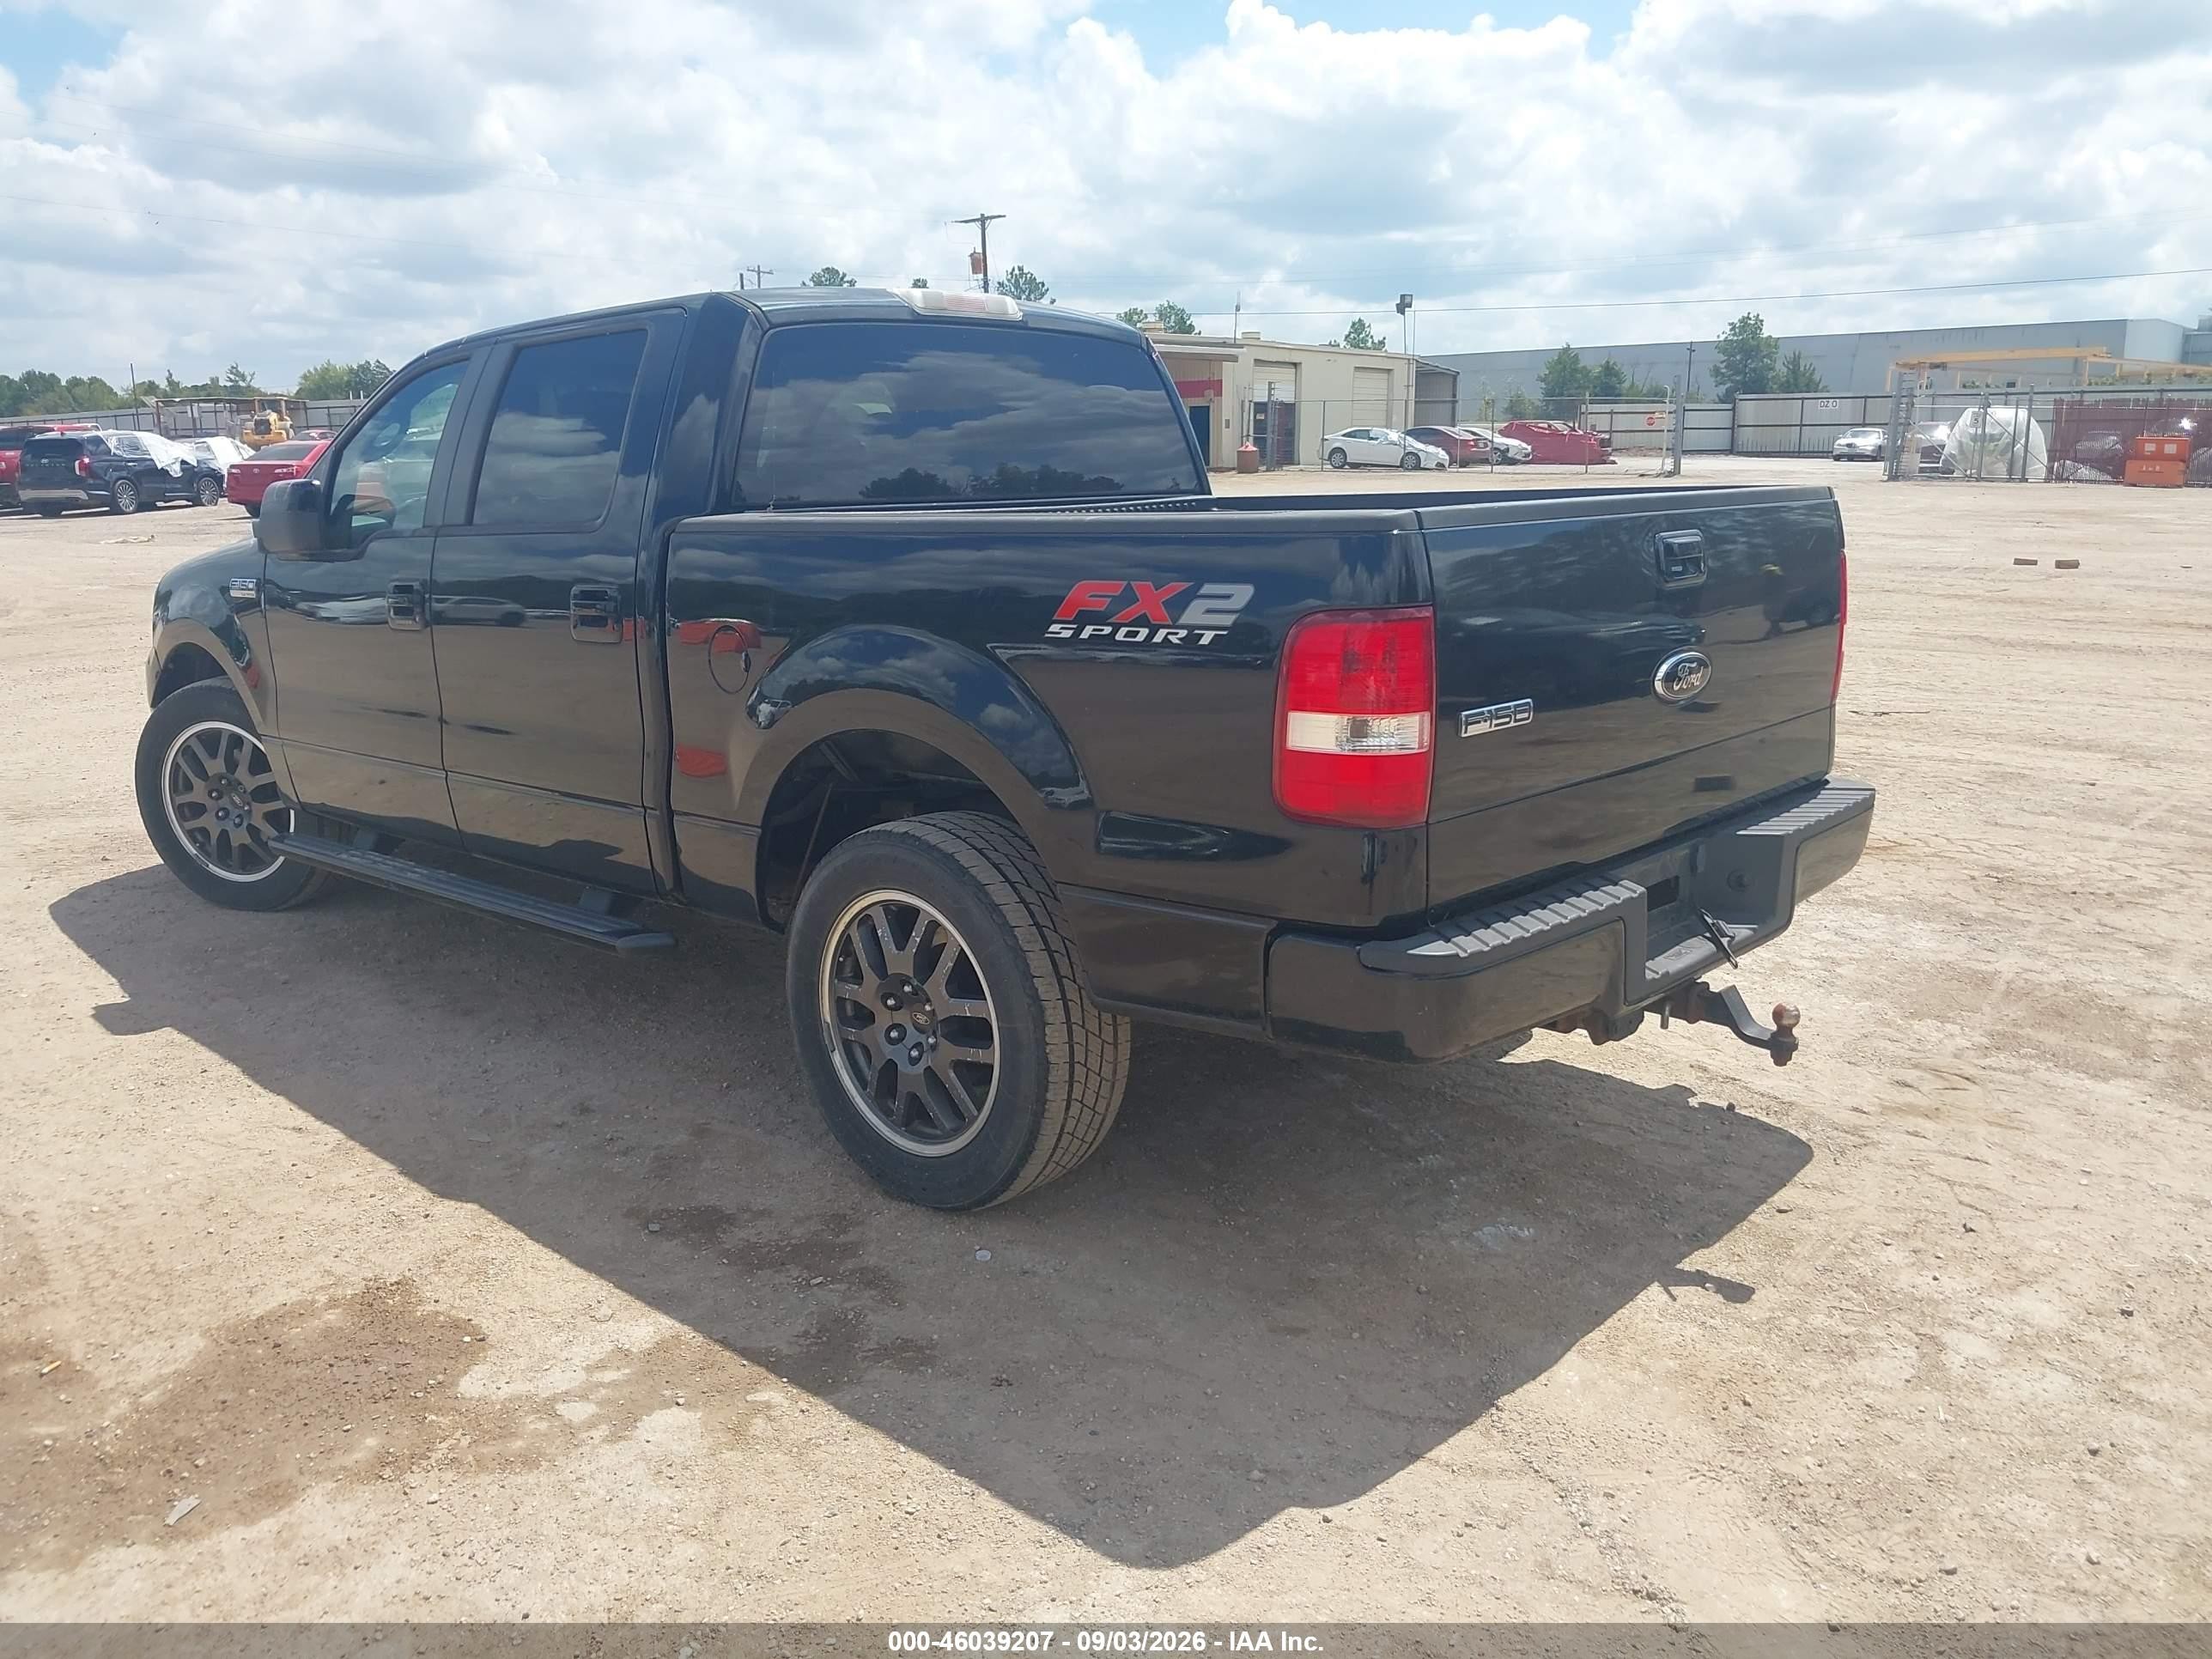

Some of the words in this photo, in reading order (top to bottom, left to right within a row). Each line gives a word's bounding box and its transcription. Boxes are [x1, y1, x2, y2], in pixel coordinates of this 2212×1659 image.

[1052, 580, 1255, 627] FX2
[1044, 623, 1230, 645] SPORT
[1673, 662, 1705, 691] Ford
